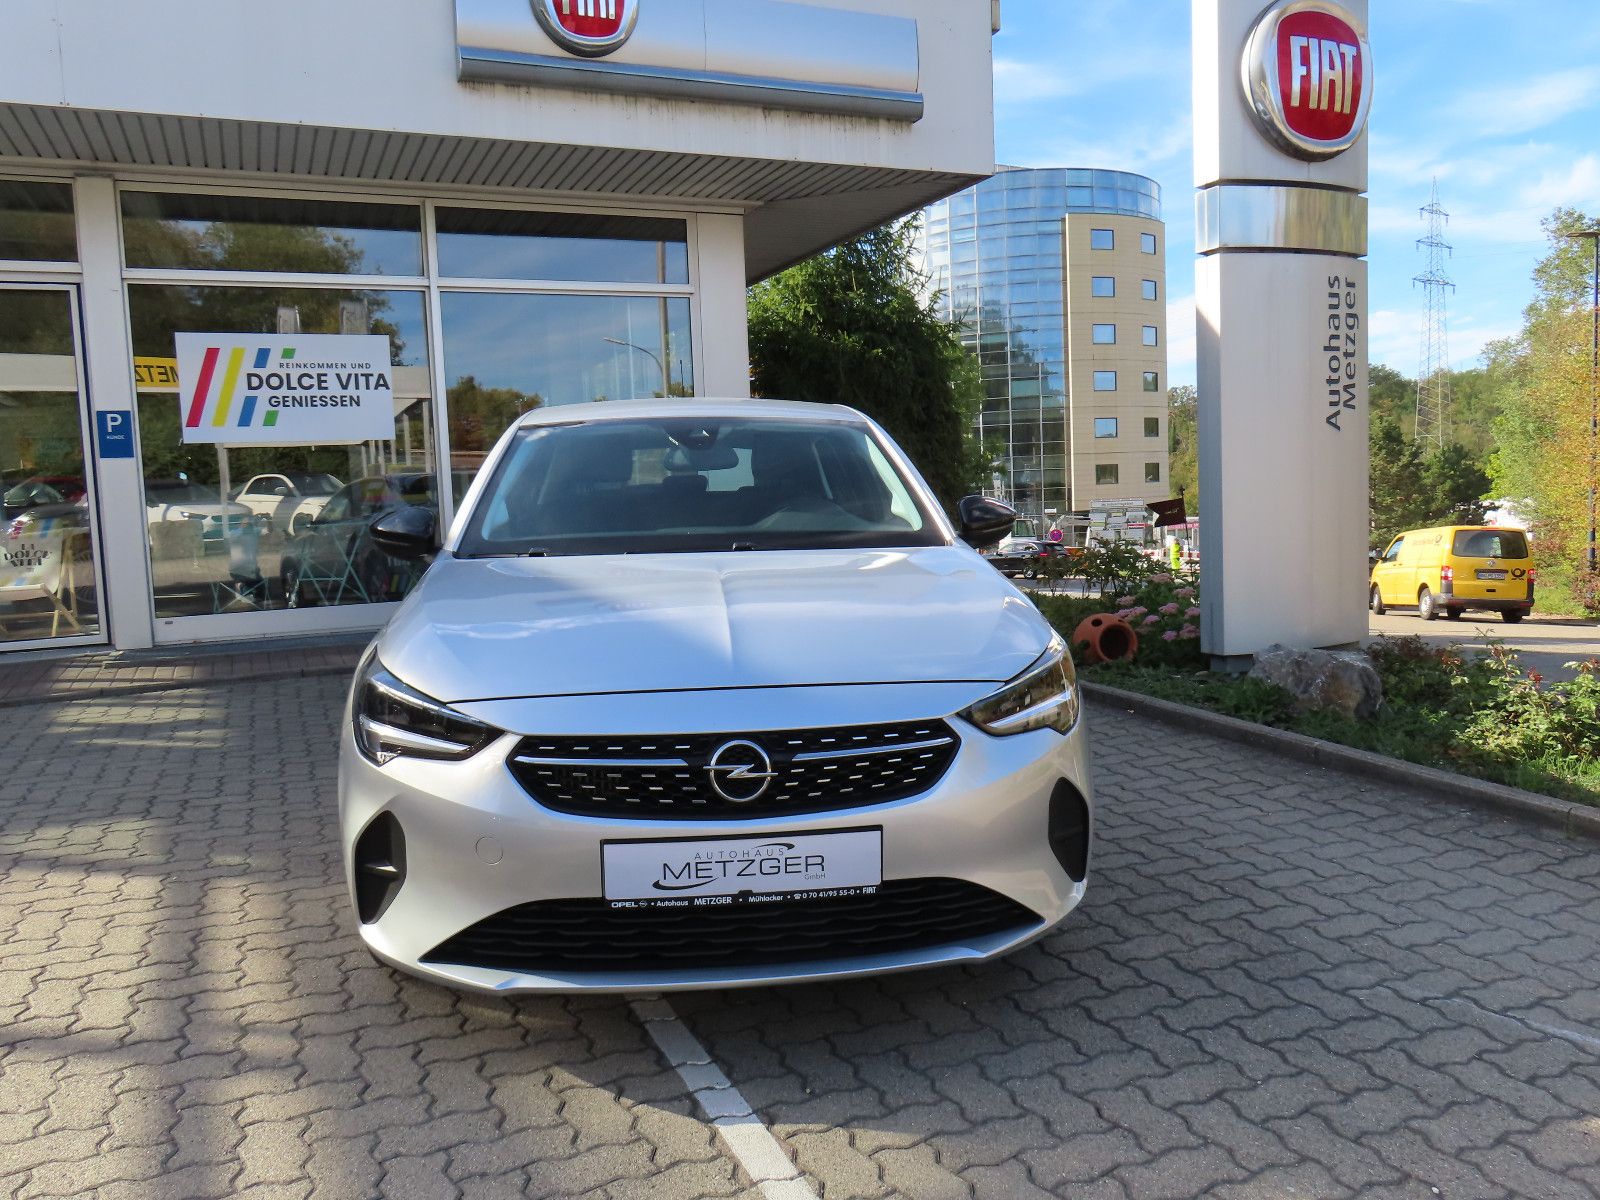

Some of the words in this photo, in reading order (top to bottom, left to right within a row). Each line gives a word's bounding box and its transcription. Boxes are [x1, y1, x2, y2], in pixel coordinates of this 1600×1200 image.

[1290, 36, 1357, 115] FIAT
[1323, 275, 1341, 431] Autohaus
[1343, 277, 1359, 410] Metzger
[246, 372, 329, 391] DOLCE
[335, 372, 391, 391] VITA
[268, 395, 361, 408] GENIESSEN
[106, 413, 123, 433] P
[694, 847, 784, 861] AUTOHAUS
[663, 854, 825, 881] METZGER
[804, 872, 826, 881] GmbH
[656, 899, 689, 907] Autohaus
[694, 896, 733, 906] METZGER
[748, 894, 784, 903] Mühlacker
[862, 886, 877, 895] FIAT
